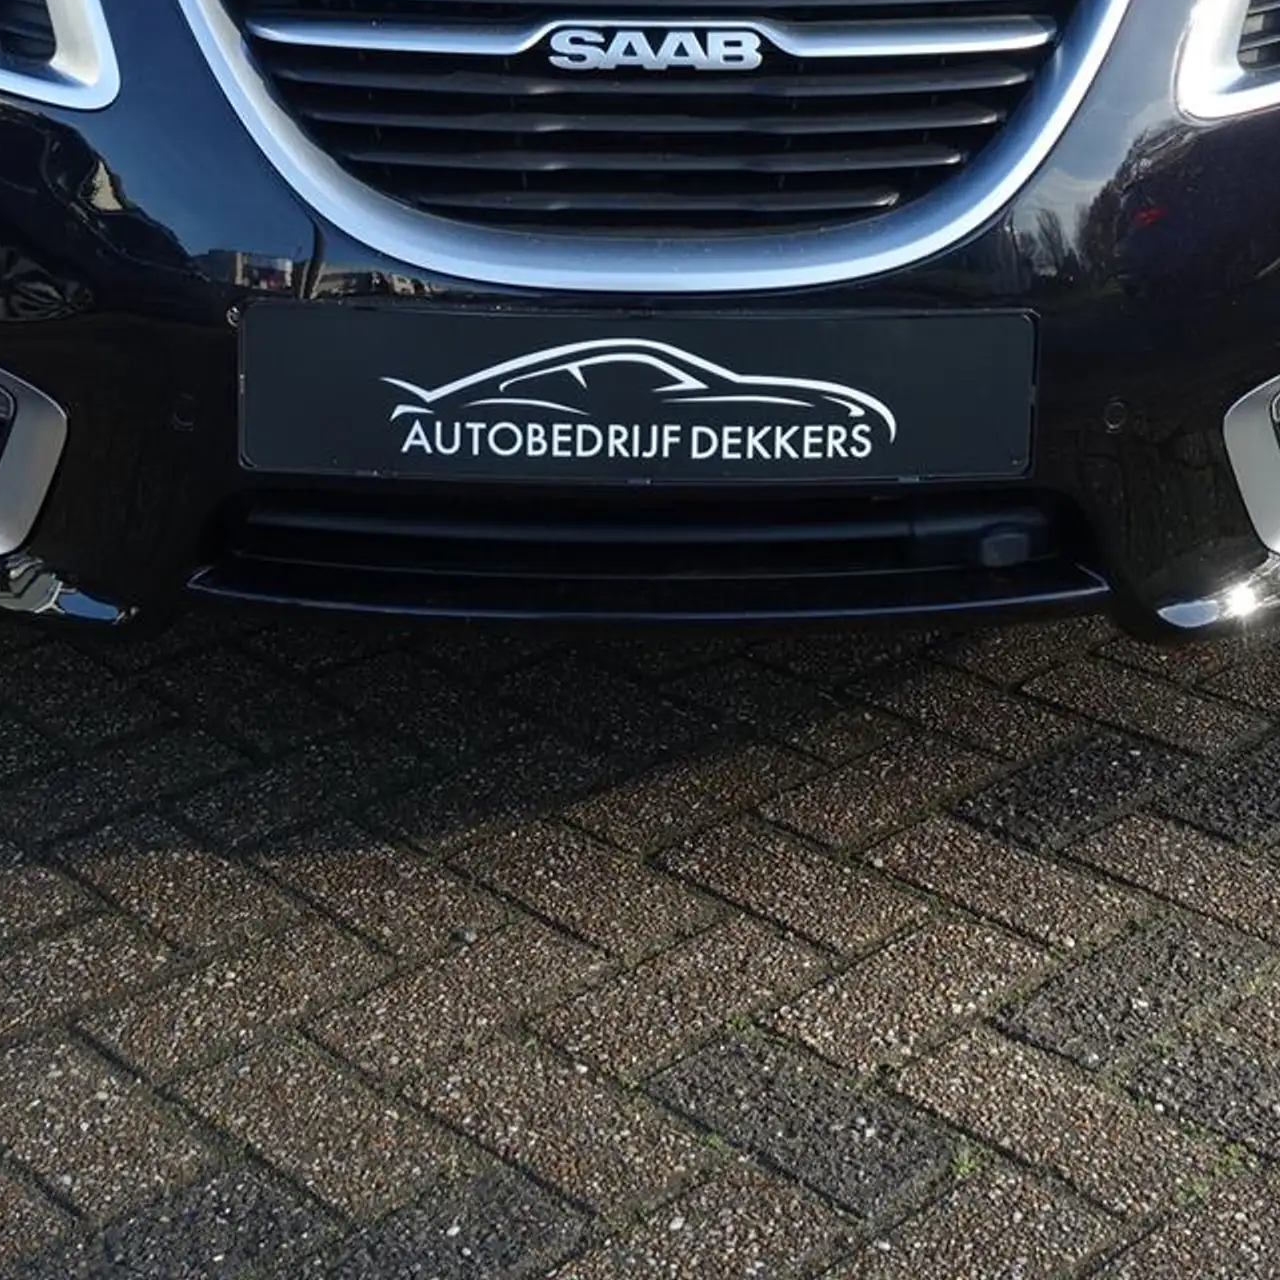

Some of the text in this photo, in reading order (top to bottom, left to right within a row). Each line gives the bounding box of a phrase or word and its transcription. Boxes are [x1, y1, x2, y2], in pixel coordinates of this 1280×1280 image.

[549, 29, 763, 70] SAAB
[401, 420, 872, 459] AUTOBEDRIJF DEKKERS
